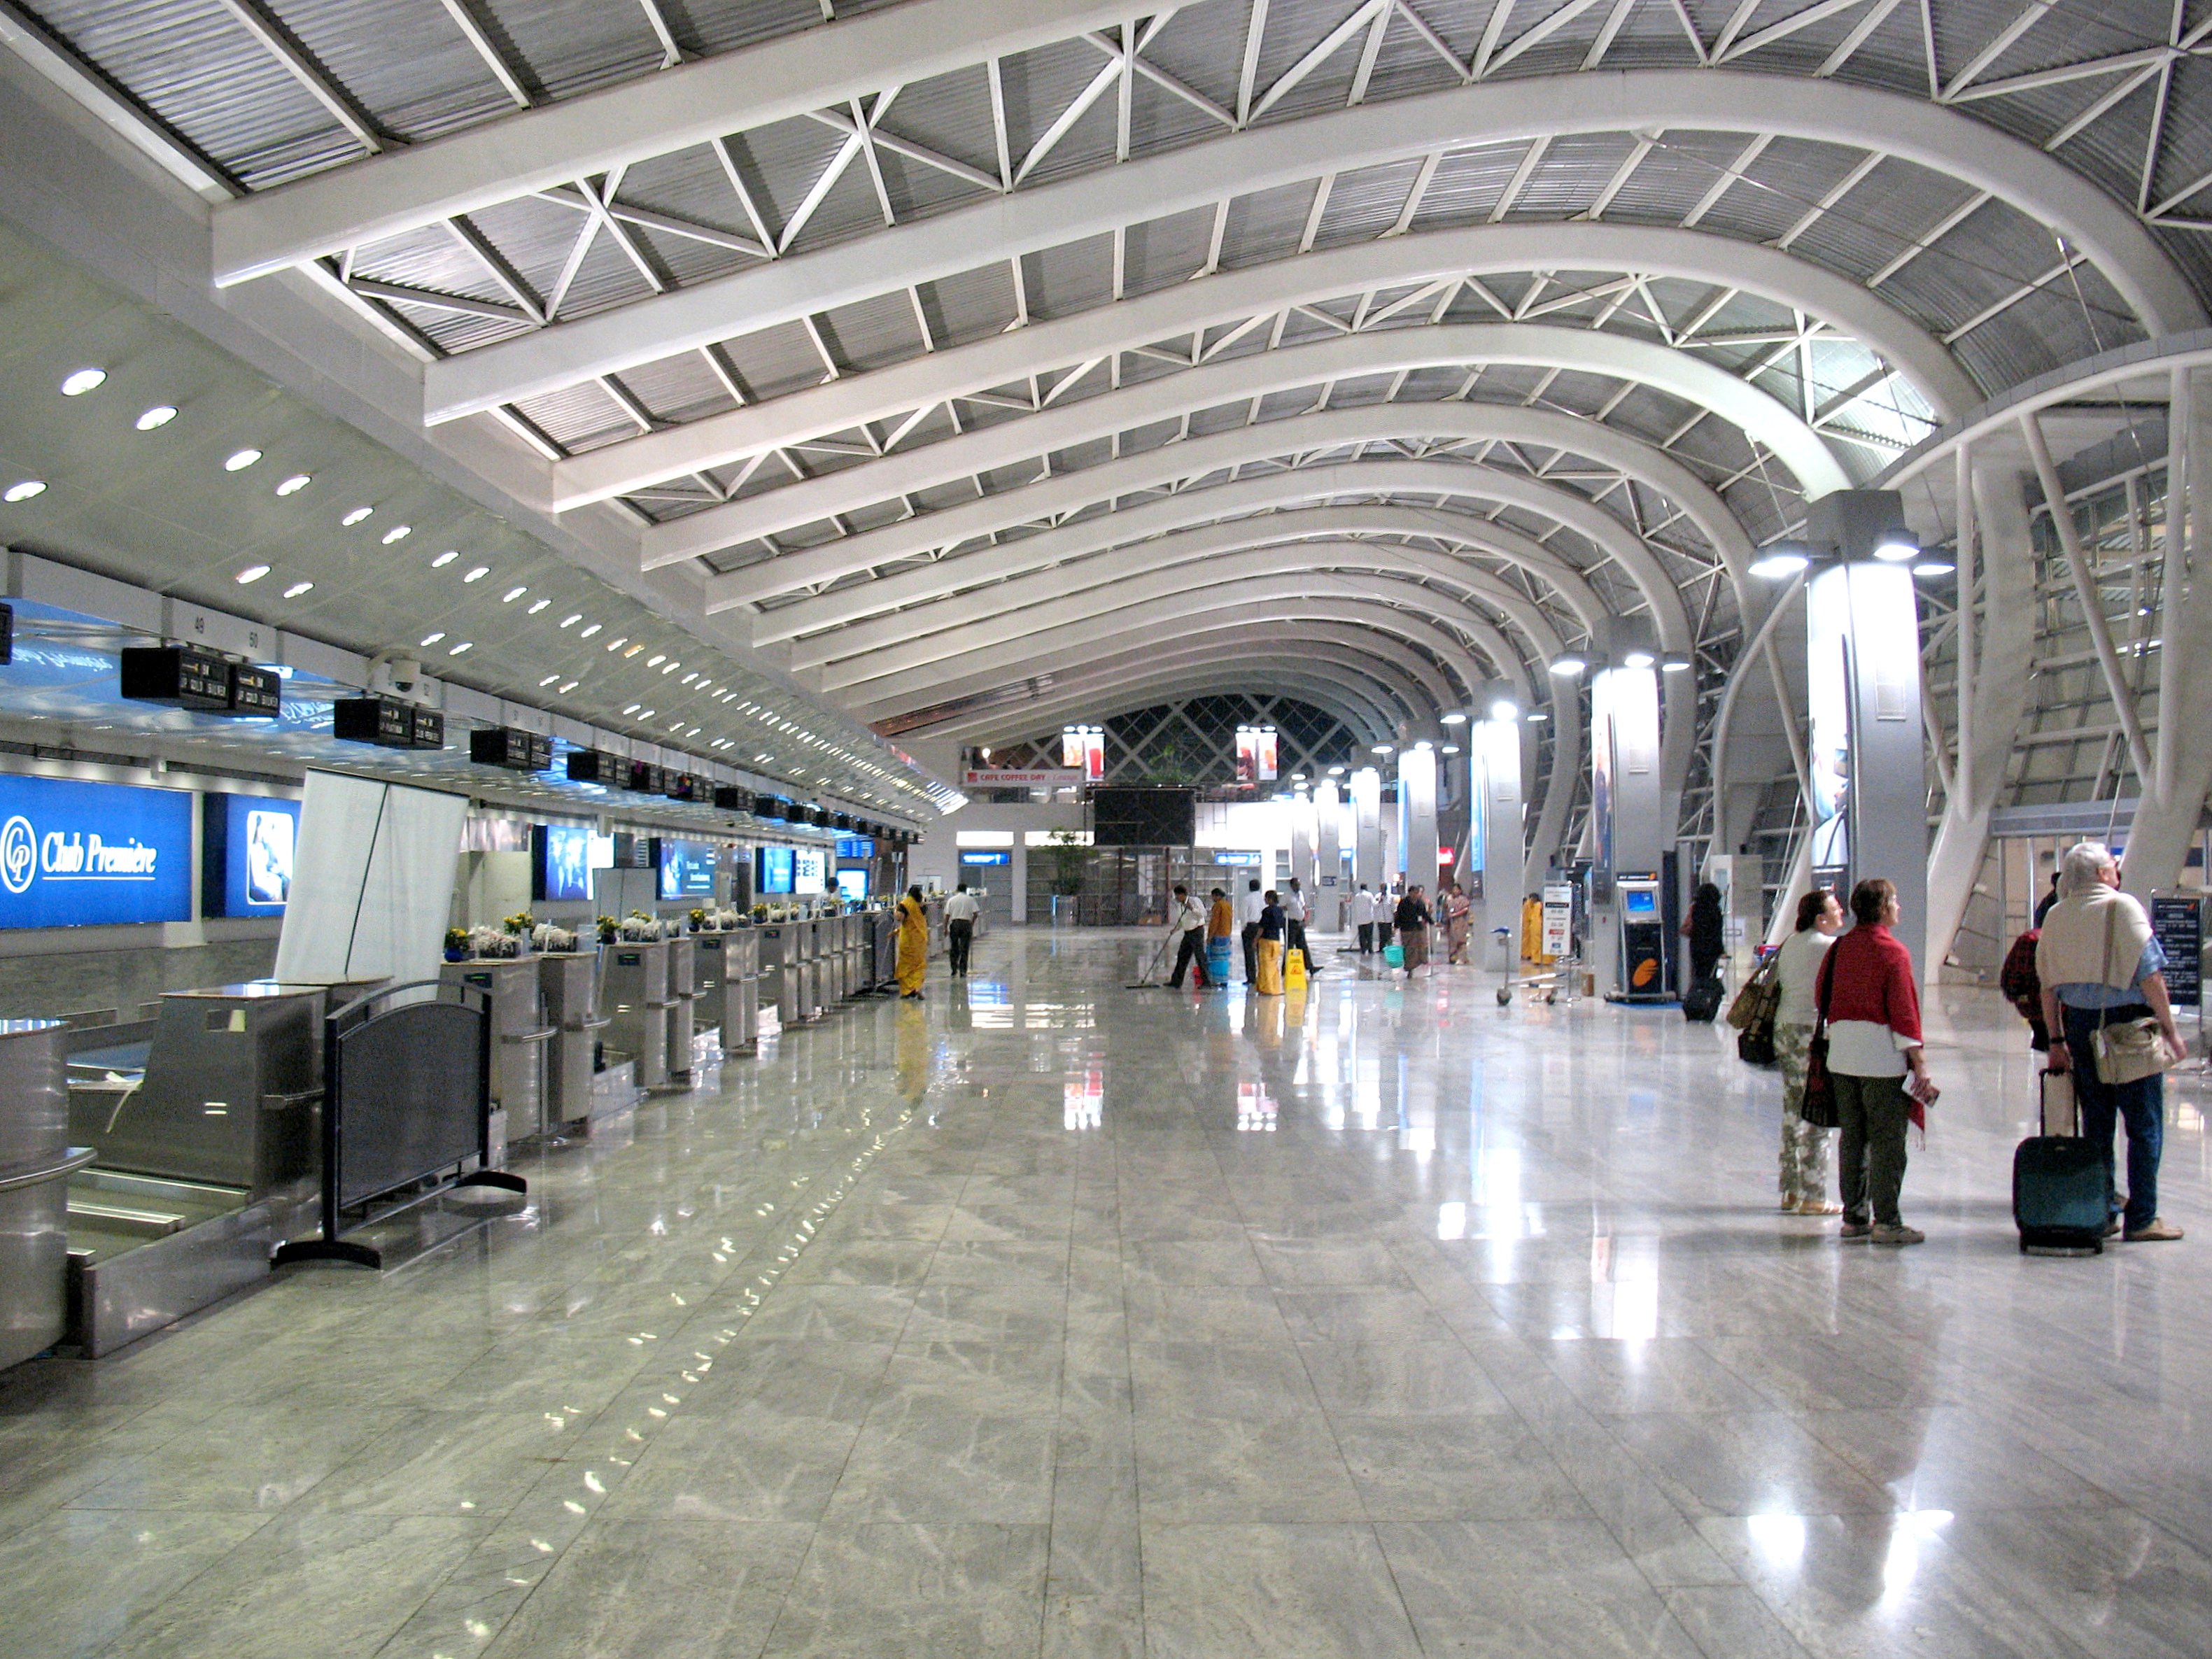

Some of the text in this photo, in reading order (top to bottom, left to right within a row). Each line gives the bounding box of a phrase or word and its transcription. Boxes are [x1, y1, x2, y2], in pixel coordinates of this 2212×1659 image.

[195, 616, 204, 634] 49
[249, 632, 259, 649] 50
[42, 831, 84, 873] Club
[85, 833, 157, 873] Première
